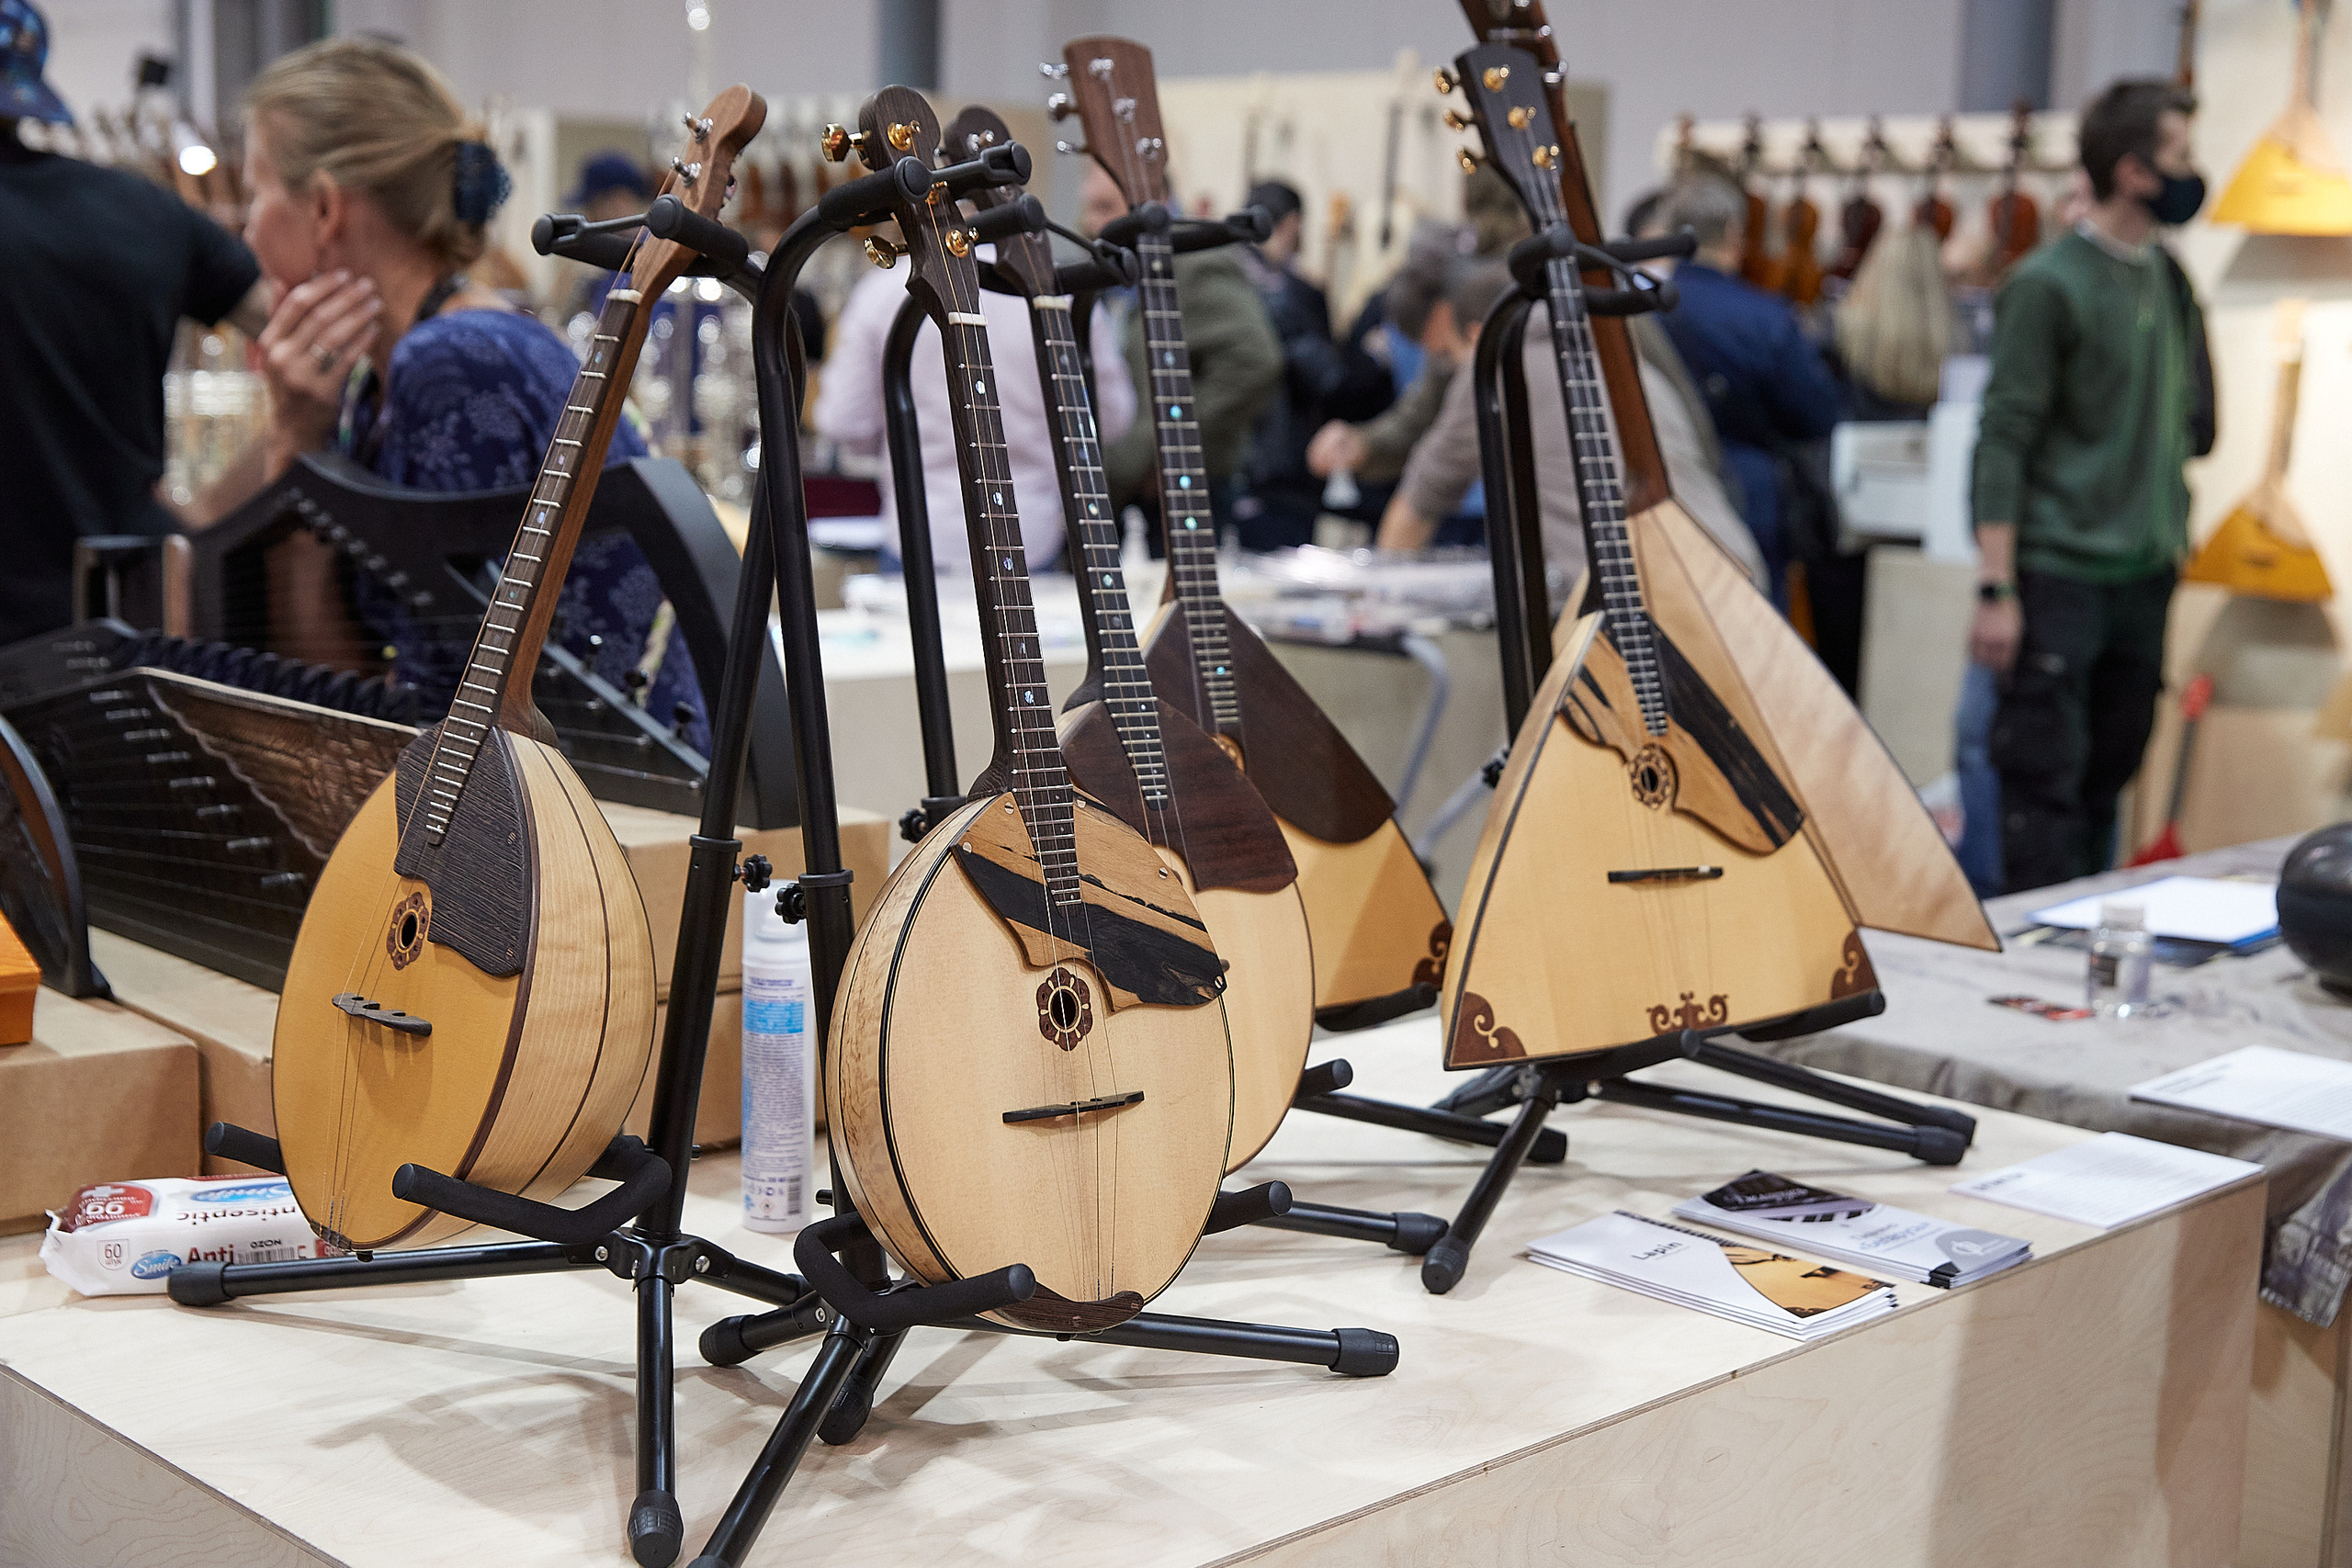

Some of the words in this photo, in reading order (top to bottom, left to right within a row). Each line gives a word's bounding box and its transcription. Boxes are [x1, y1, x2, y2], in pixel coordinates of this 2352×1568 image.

[176, 1205, 296, 1225] ntiseptic
[104, 1243, 122, 1259] 60
[134, 1257, 179, 1277] Smile
